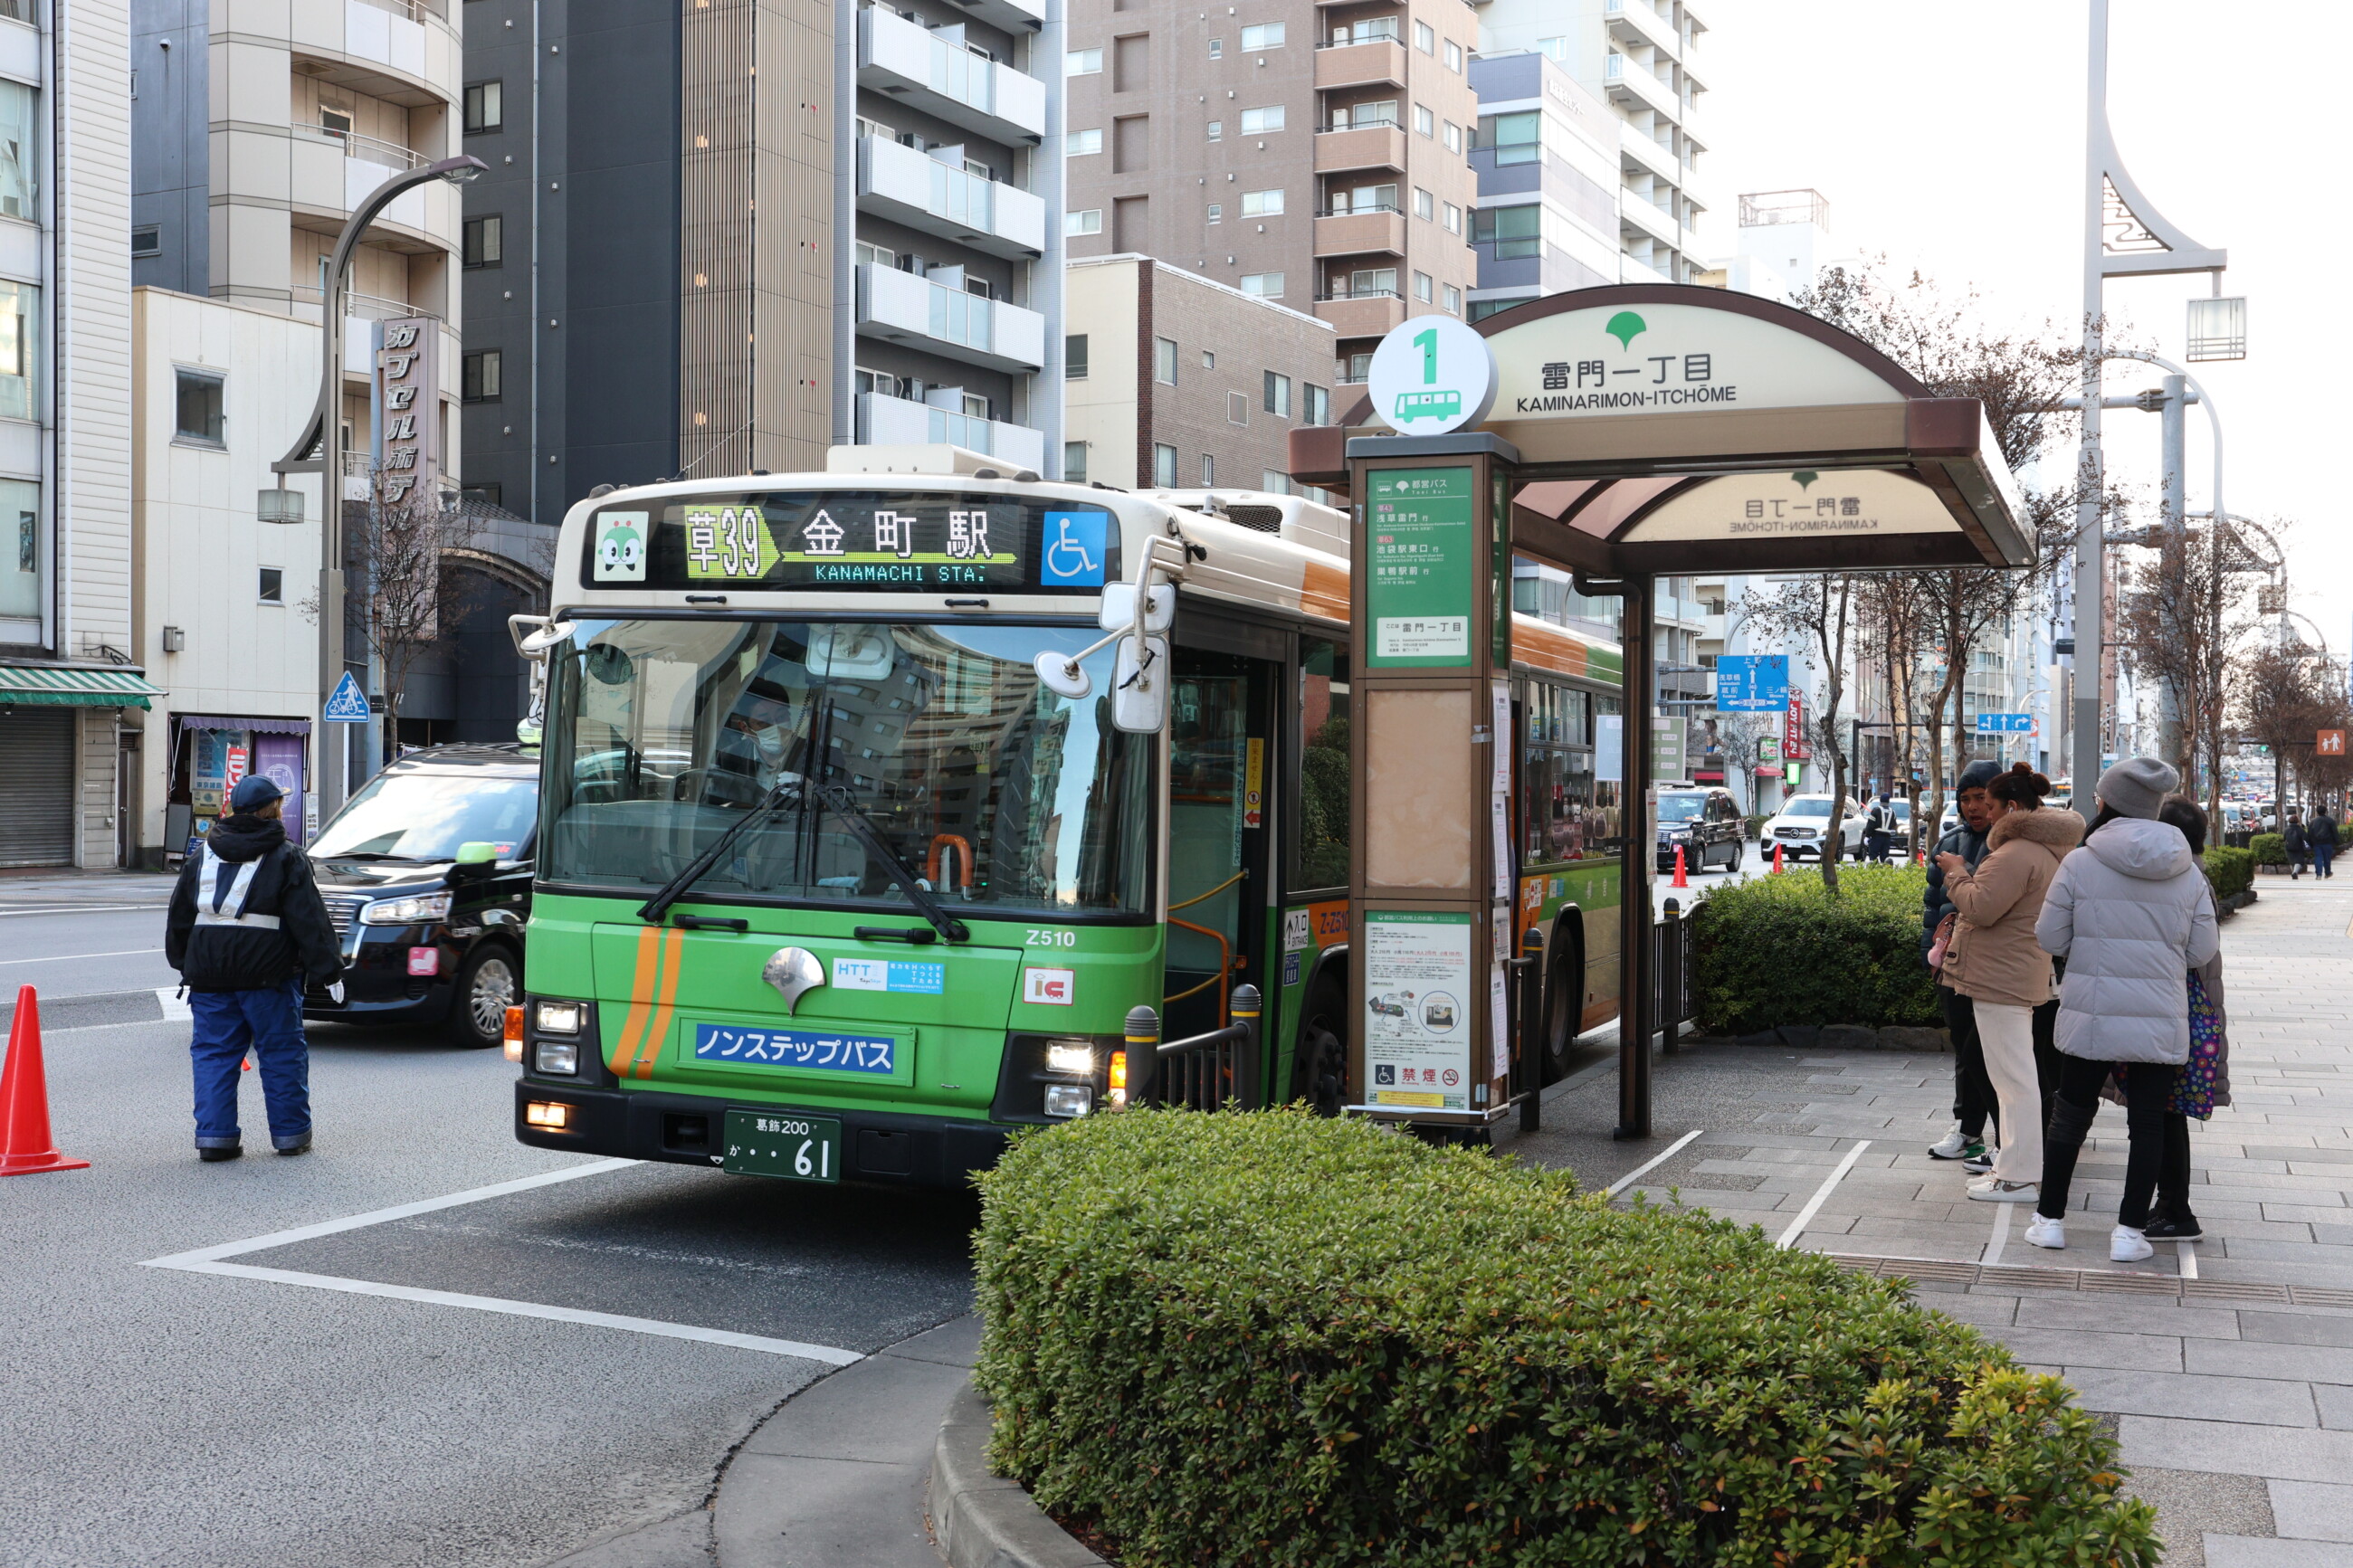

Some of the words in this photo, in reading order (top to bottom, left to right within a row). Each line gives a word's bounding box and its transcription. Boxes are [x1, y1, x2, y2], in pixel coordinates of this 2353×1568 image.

[1414, 328, 1437, 385] 1
[1542, 354, 1711, 390] 雷門一丁目
[1517, 385, 1737, 413] KAMINARIMON-ITCHŌME
[687, 508, 759, 576] 草39
[815, 565, 923, 582] KANAMACHI
[1403, 622, 1462, 632] 雷門一丁目
[1026, 929, 1075, 946] Z510
[838, 963, 871, 976] HTT
[697, 1030, 892, 1069] ノンステップバス
[1402, 1068, 1436, 1082] 禁煙
